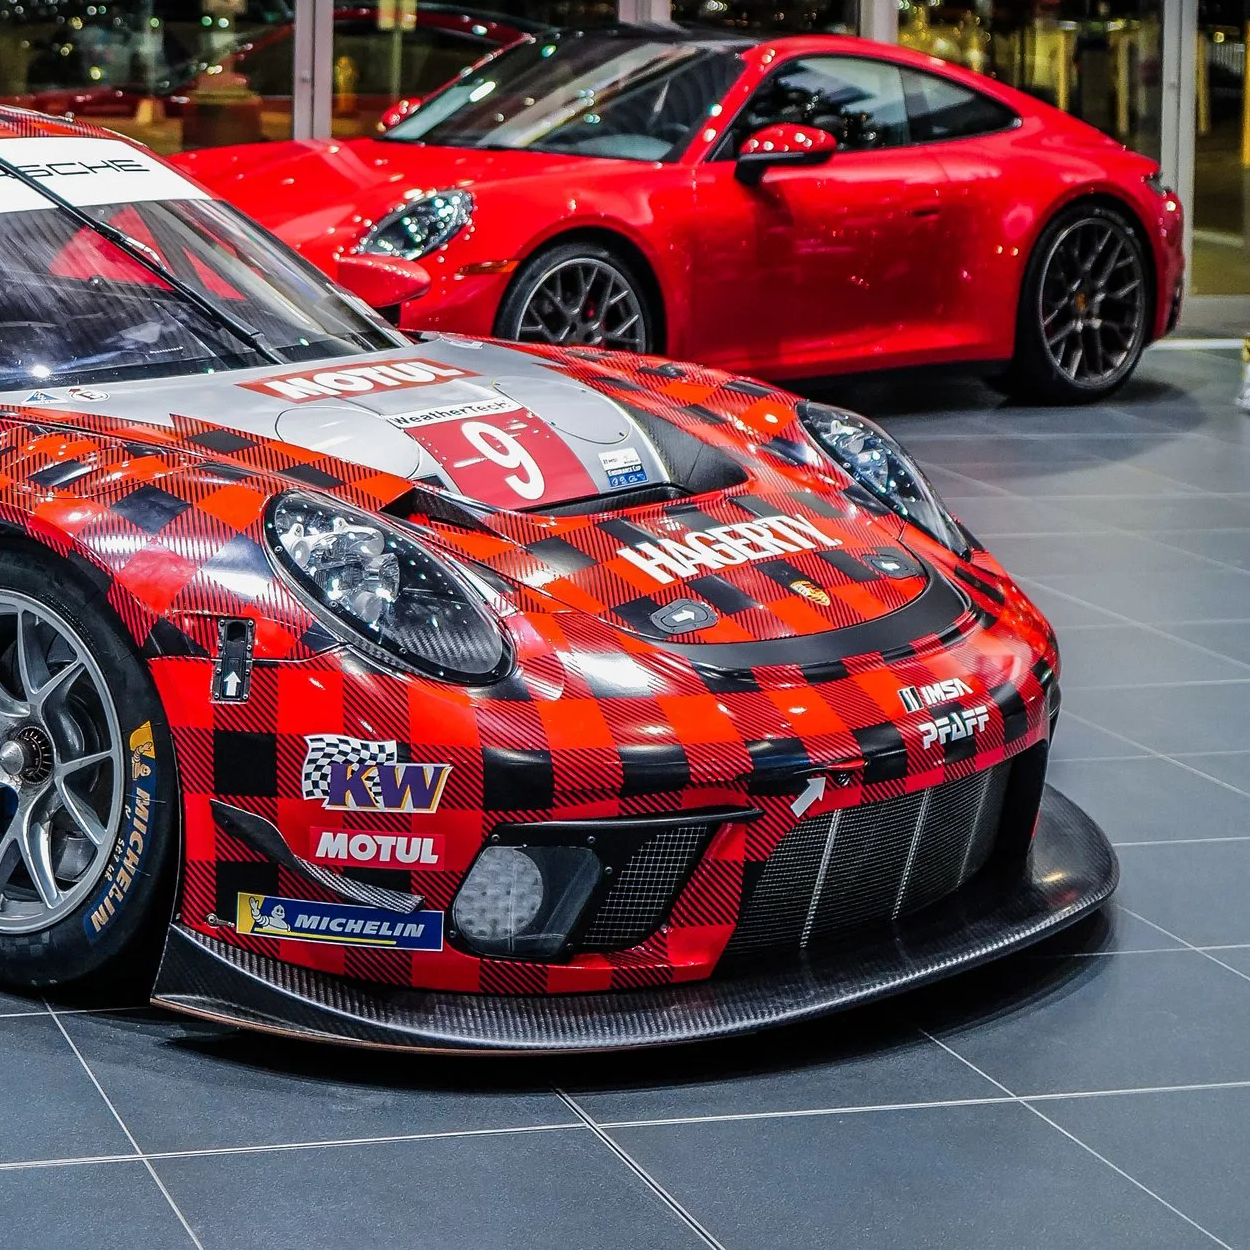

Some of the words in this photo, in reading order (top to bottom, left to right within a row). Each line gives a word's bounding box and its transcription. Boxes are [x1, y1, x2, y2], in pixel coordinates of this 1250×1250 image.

[263, 362, 466, 400] MOTUL
[391, 400, 511, 427] WeatherTech
[461, 421, 545, 500] 9
[615, 513, 841, 585] HAGERTY
[920, 677, 974, 705] IMSA
[917, 705, 990, 750] PFAFF
[327, 763, 452, 812] KW
[91, 786, 150, 932] MICHELIN
[315, 831, 439, 864] MOTUL
[294, 914, 426, 938] MICHELIN
